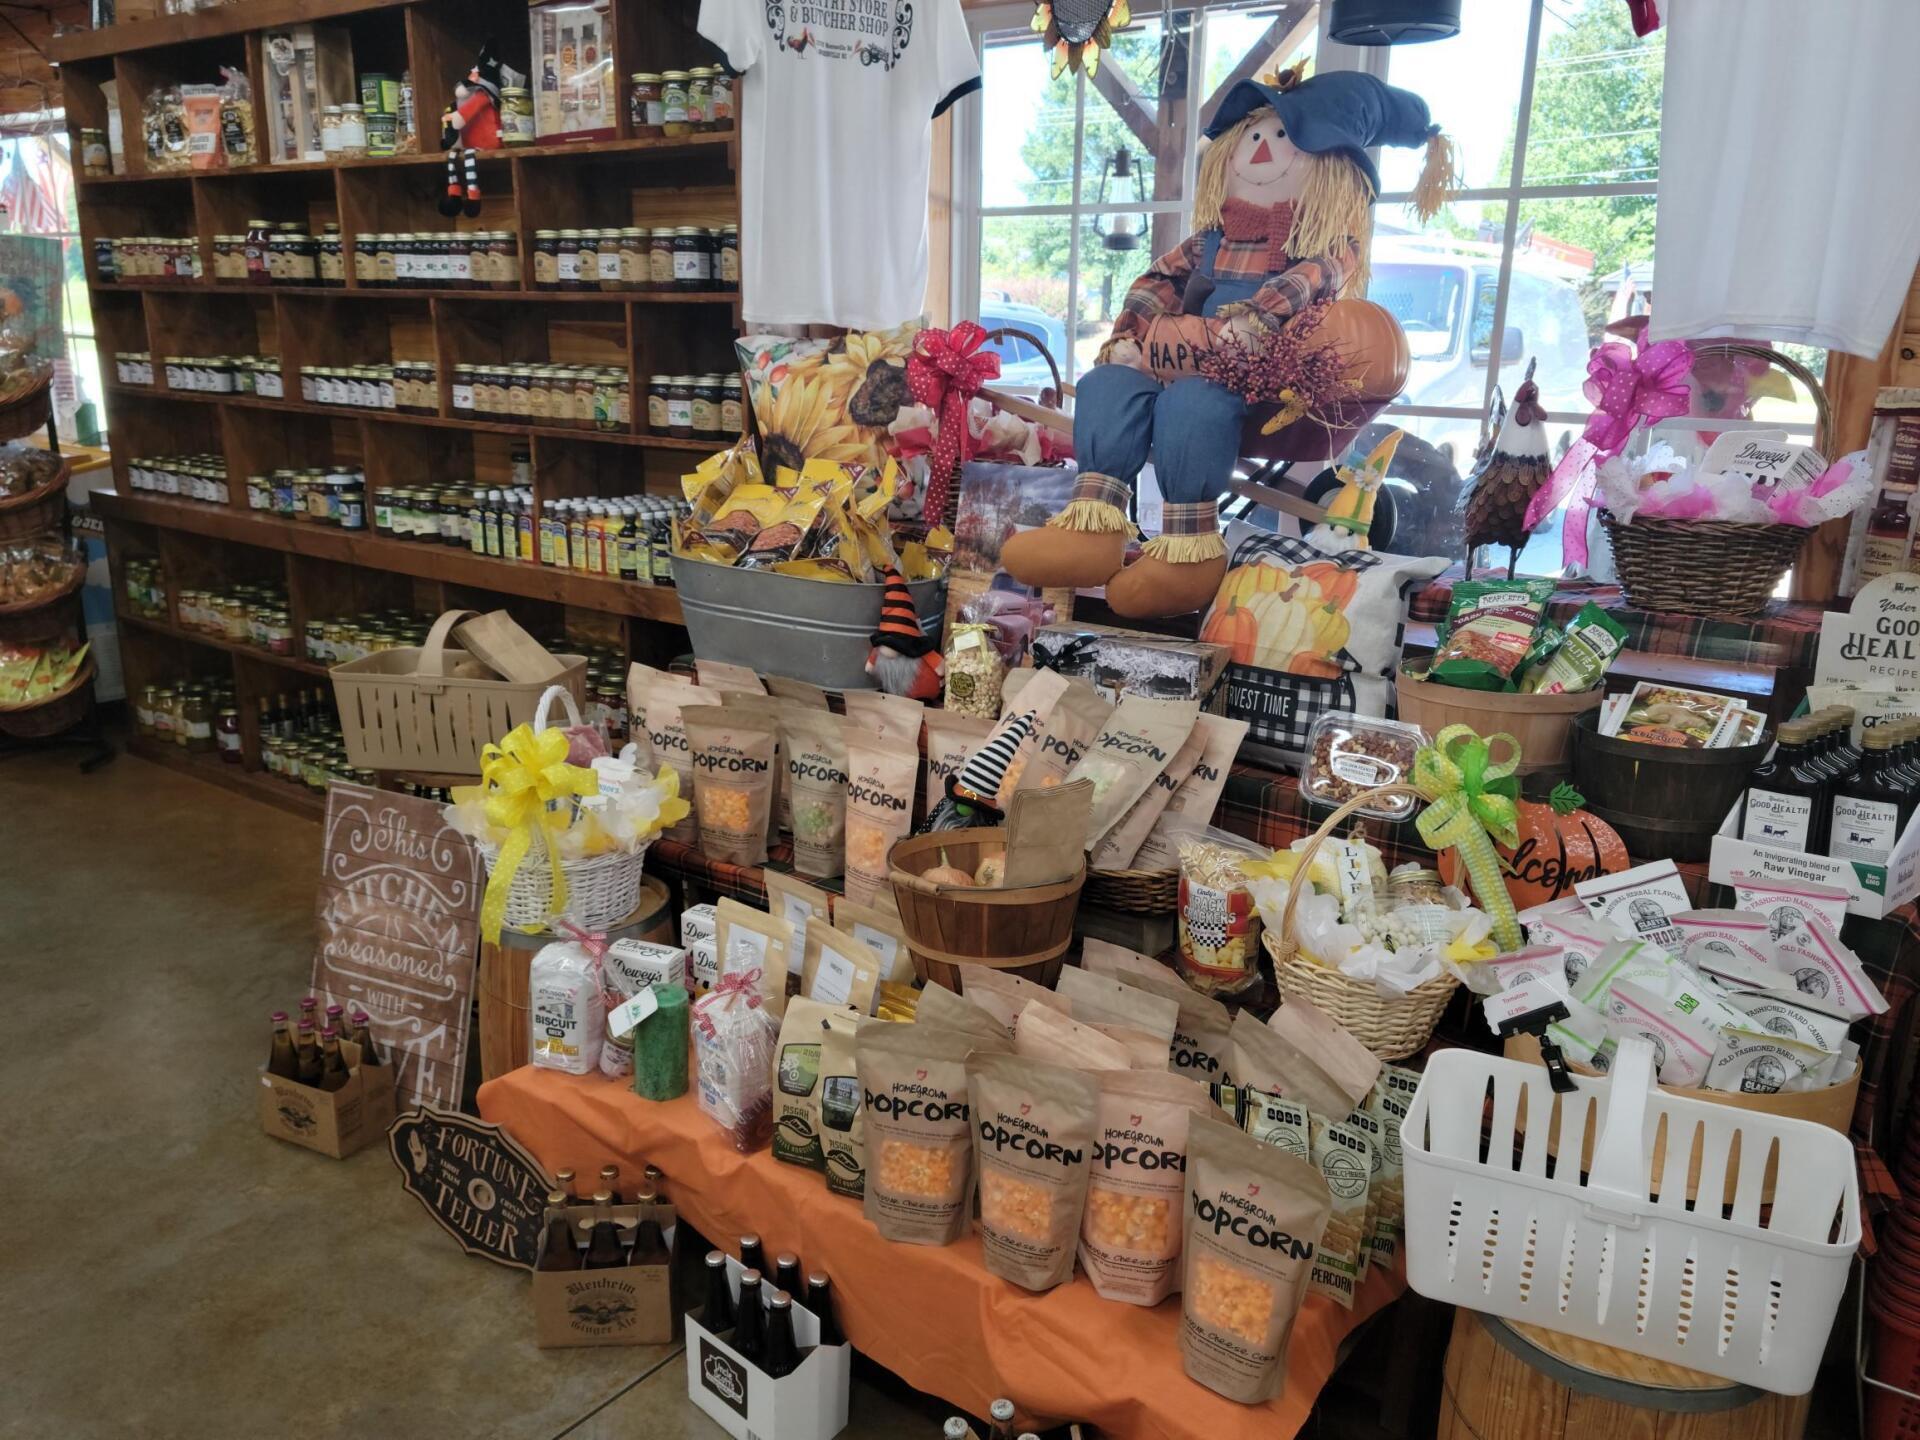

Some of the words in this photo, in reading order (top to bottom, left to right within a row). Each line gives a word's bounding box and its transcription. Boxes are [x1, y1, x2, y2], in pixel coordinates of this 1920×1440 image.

[790, 6, 798, 23] &
[802, 6, 856, 31] BUTCHER
[858, 15, 889, 37] SHOP
[849, 0, 888, 19] STORE
[1150, 342, 1203, 372] HAP
[1736, 442, 1792, 470] Dewey's
[1515, 609, 1538, 621] CHIL
[1876, 617, 1920, 637] GOO
[1840, 632, 1920, 662] HEAL
[1229, 684, 1260, 712] RVEST
[1263, 691, 1292, 718] TIME
[692, 751, 768, 773] POPCORN
[789, 760, 849, 784] OPCORN
[930, 759, 963, 779] POPC
[848, 782, 907, 811] OPCORN
[1749, 798, 1771, 809] GOOD
[1771, 803, 1809, 815] HEALTH
[1834, 805, 1857, 816] GOOD
[1857, 809, 1896, 822] HEALTH
[373, 807, 429, 861] This
[1753, 849, 1763, 858] An
[1764, 851, 1808, 867] Invigorating
[1809, 861, 1829, 873] blend
[1831, 865, 1841, 874] of
[1763, 861, 1786, 874] Raw
[1788, 867, 1828, 883] Vinegar
[1197, 887, 1217, 898] Cindy's
[1793, 897, 1814, 911] HARD
[321, 872, 468, 965] KITCHEN
[1184, 905, 1237, 924] CRACKERS
[383, 914, 401, 942] IS
[337, 936, 445, 983] seasoned
[613, 958, 663, 987] Dewey's
[366, 988, 405, 1016] WITH
[535, 1015, 578, 1030] BISCUIT
[1736, 1045, 1776, 1058] FASHIONED
[1775, 1046, 1796, 1062] HARD
[892, 1082, 948, 1101] HOMEGROWN
[783, 1104, 810, 1120] PISGAH
[997, 1112, 1049, 1139] HOMEGROWN
[829, 1139, 854, 1152] PISGAH
[980, 1120, 1083, 1167] OPCORN
[1104, 1128, 1165, 1148] HOMEGROWN
[434, 1126, 543, 1216] FORTUNE
[435, 1179, 519, 1259] TELLER
[1219, 1191, 1277, 1227] HOMEGROWN
[565, 1277, 637, 1296] Blenheim
